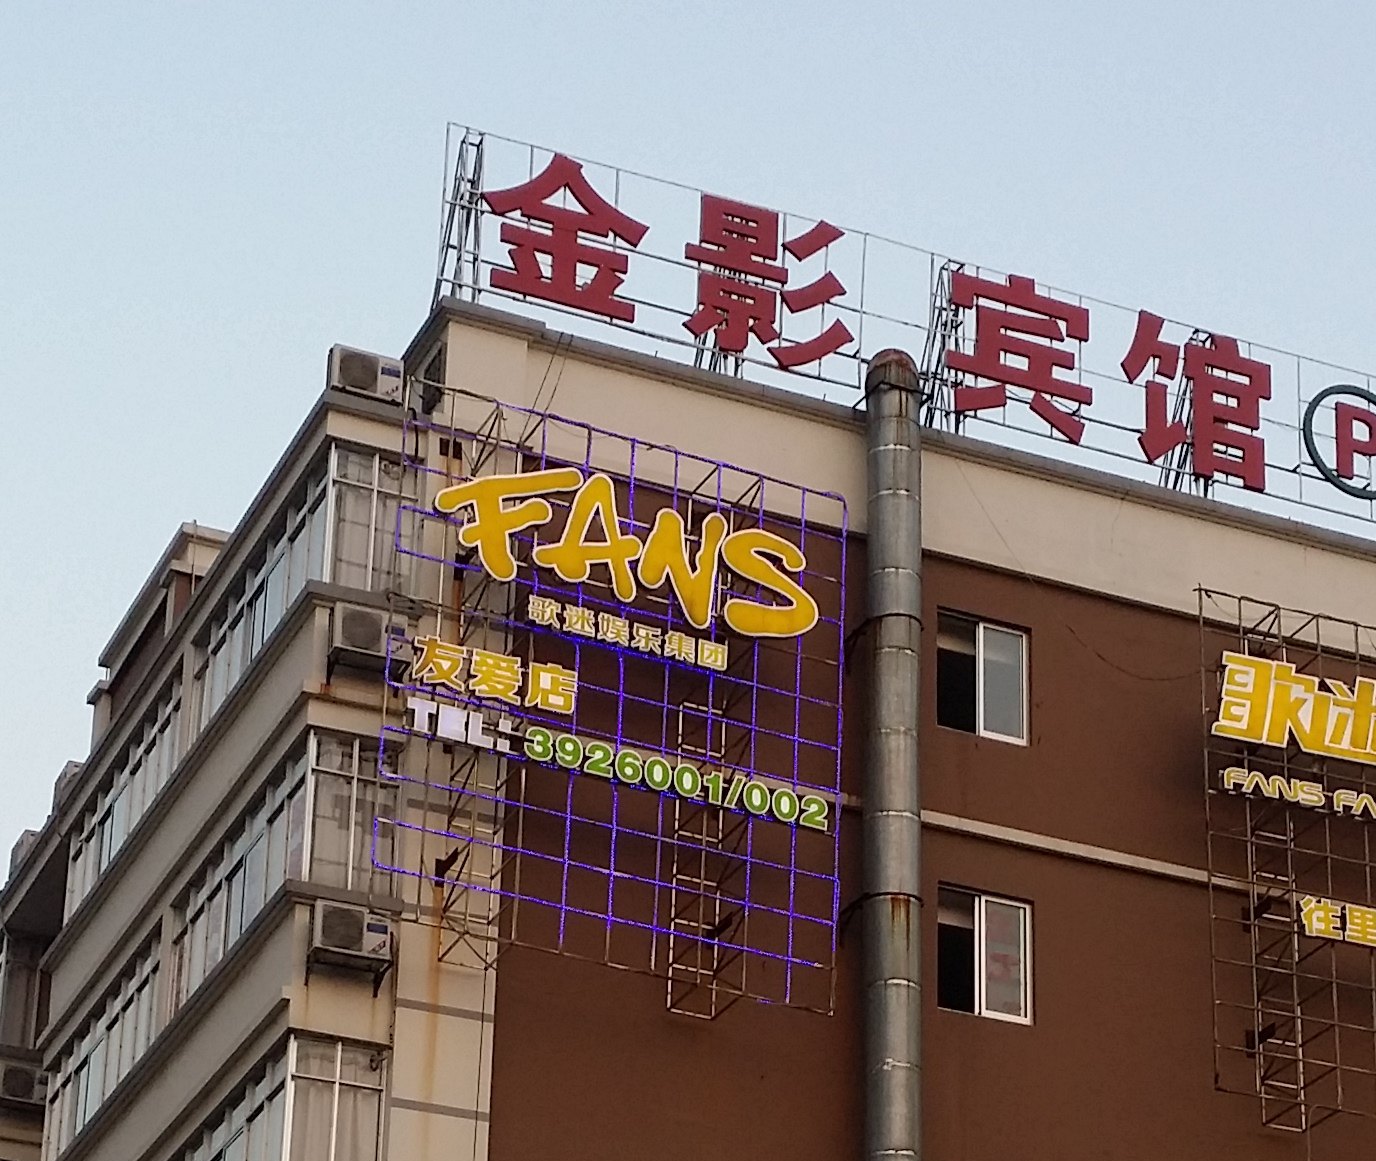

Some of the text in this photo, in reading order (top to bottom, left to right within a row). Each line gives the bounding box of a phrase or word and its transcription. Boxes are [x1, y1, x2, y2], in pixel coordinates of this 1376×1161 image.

[480, 152, 1274, 493] 金影宾馆
[436, 467, 819, 637] FANS
[412, 635, 578, 714] 友爱店
[527, 593, 729, 672] 歌迷娱乐集团
[407, 695, 830, 831] TEL: 3926001/002
[1223, 766, 1326, 808] FANS
